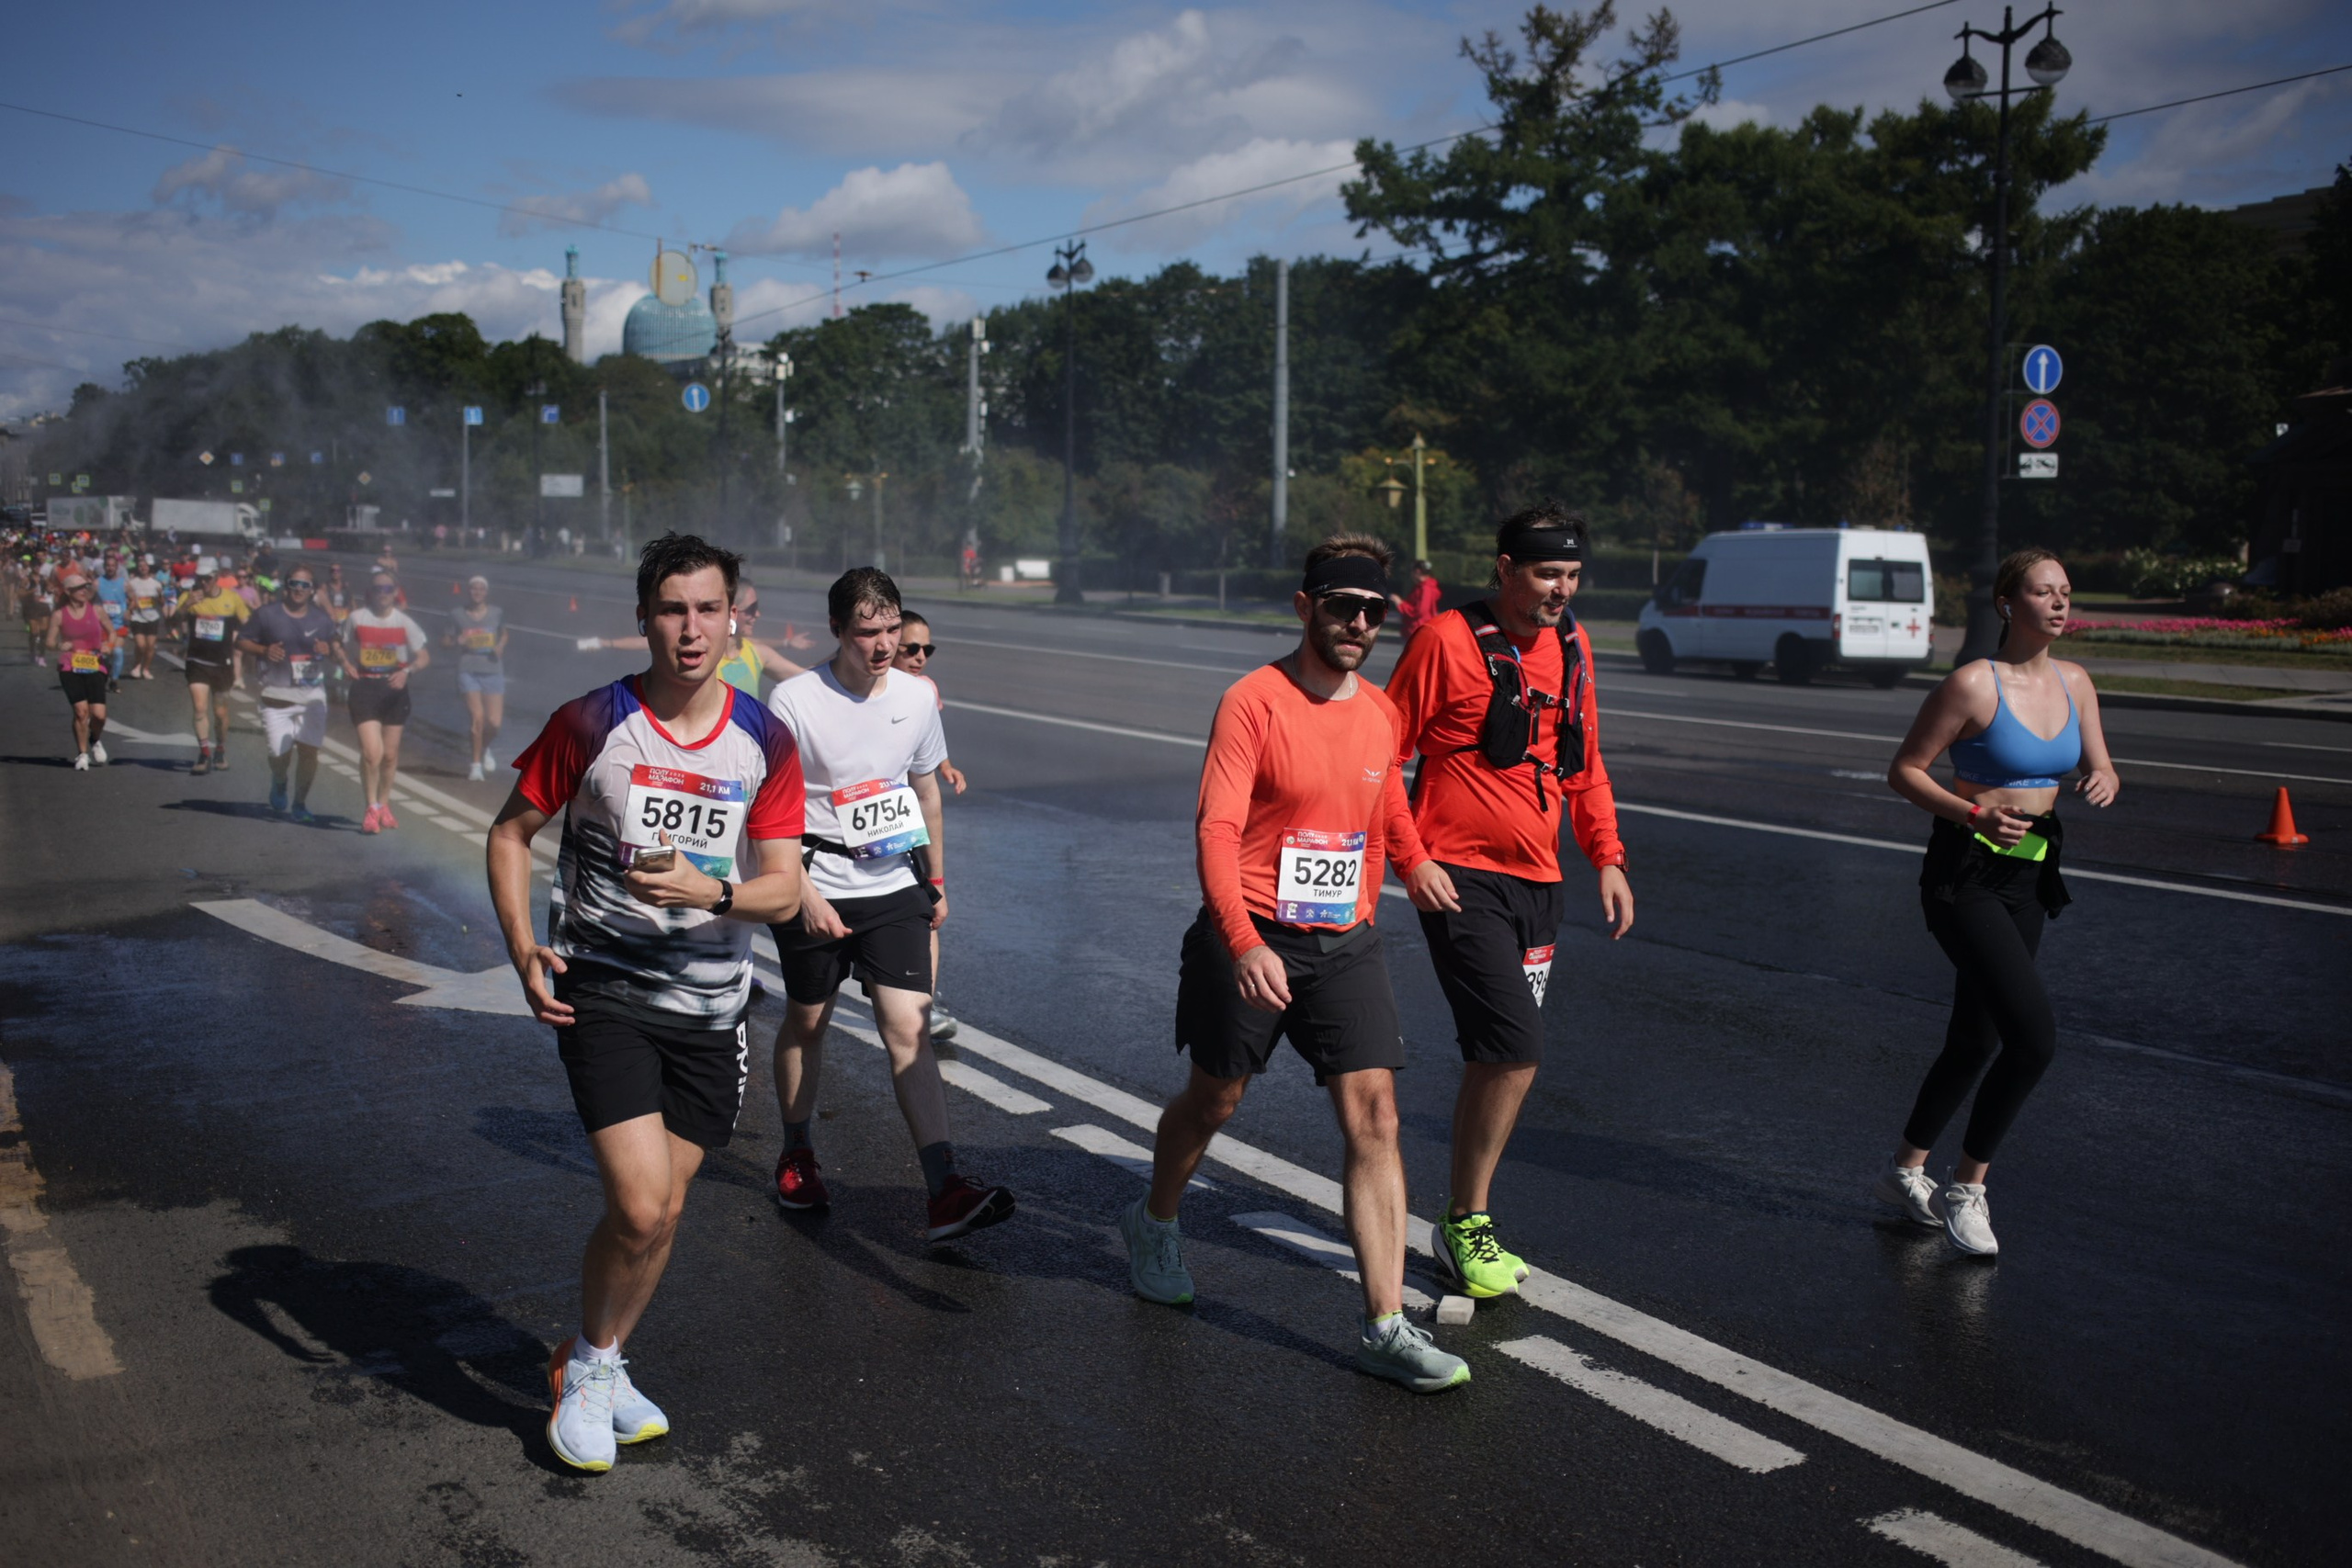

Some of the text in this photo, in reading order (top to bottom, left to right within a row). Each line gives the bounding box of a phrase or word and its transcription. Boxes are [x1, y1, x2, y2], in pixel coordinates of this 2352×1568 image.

[699, 783, 717, 794] 21,1
[2004, 778, 2030, 787] NIKE
[641, 796, 729, 840] 5815
[852, 795, 910, 831] 6754
[867, 820, 904, 838] НИКОЛАЙ
[1295, 857, 1357, 887] 5282
[1314, 889, 1342, 898] ТИМУР
